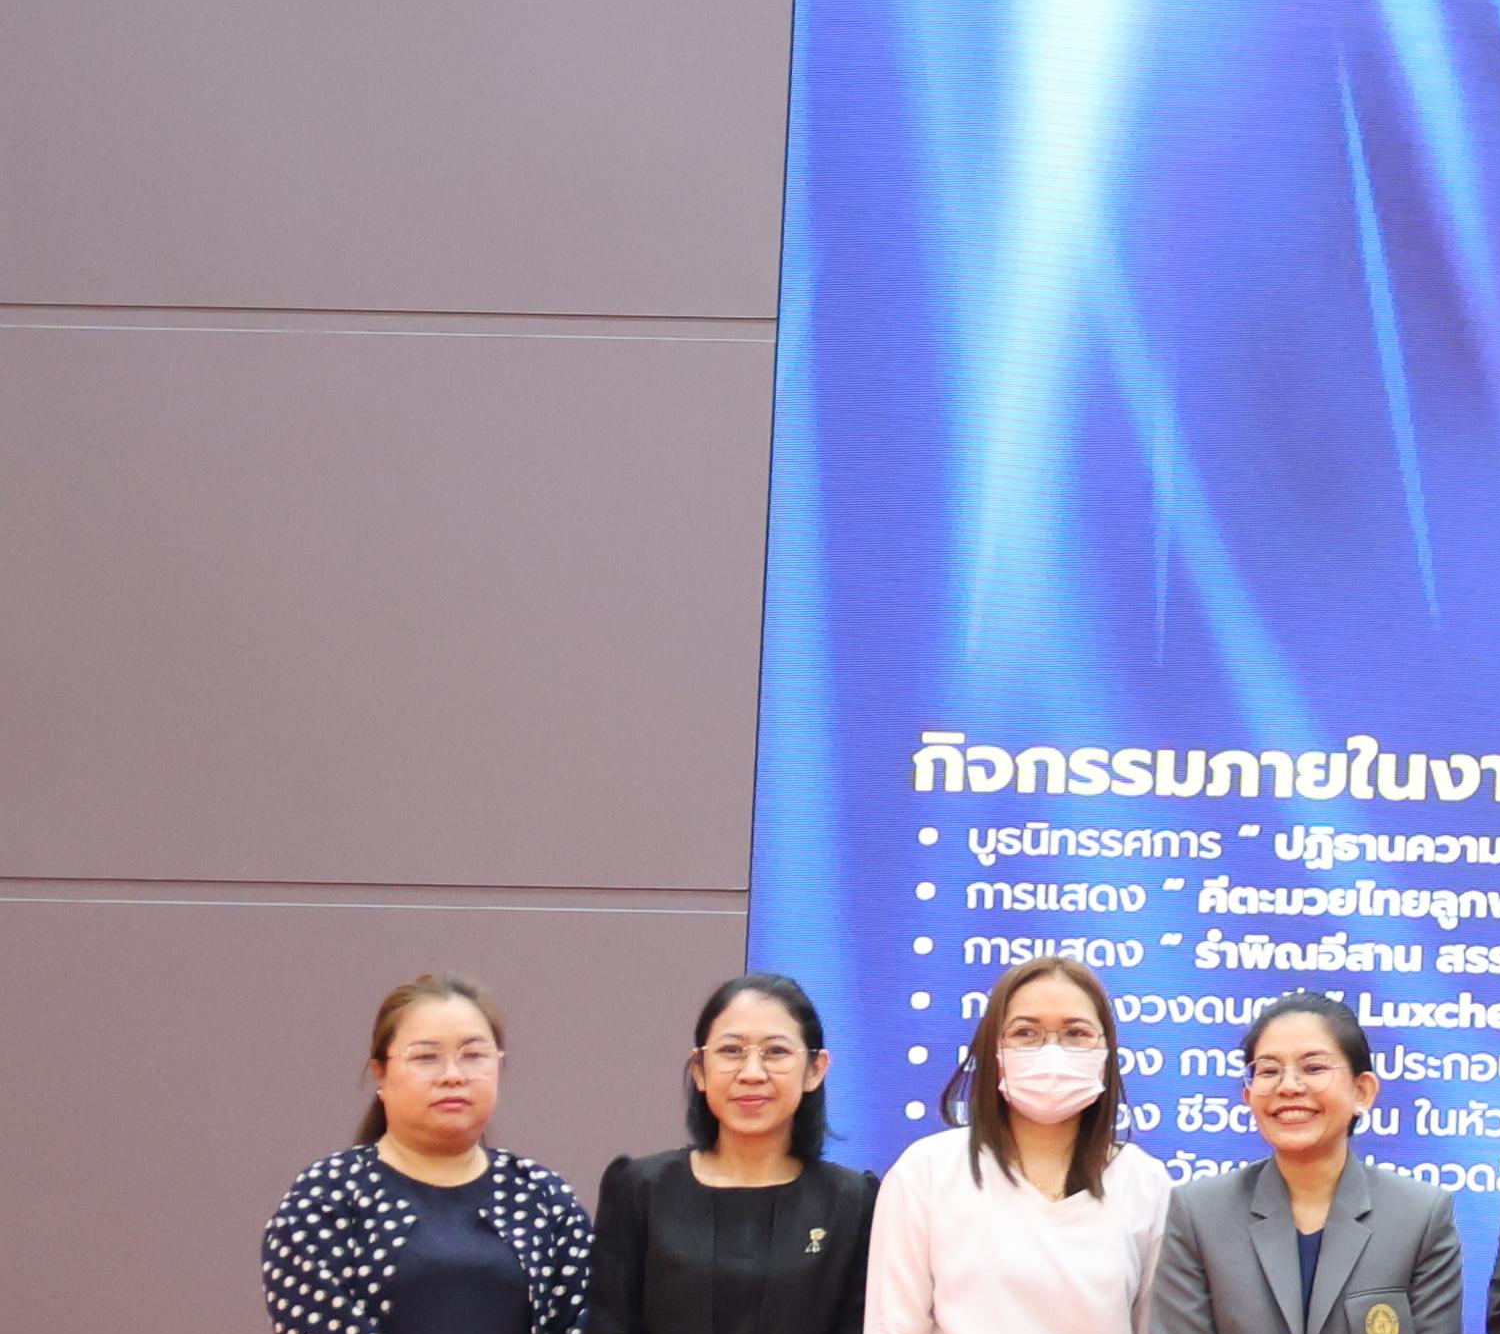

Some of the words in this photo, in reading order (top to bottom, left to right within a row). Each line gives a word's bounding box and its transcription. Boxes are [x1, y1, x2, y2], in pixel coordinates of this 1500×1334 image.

[968, 822, 1223, 866] บูธนิทรรศการ
[965, 882, 1147, 913] การแสดง
